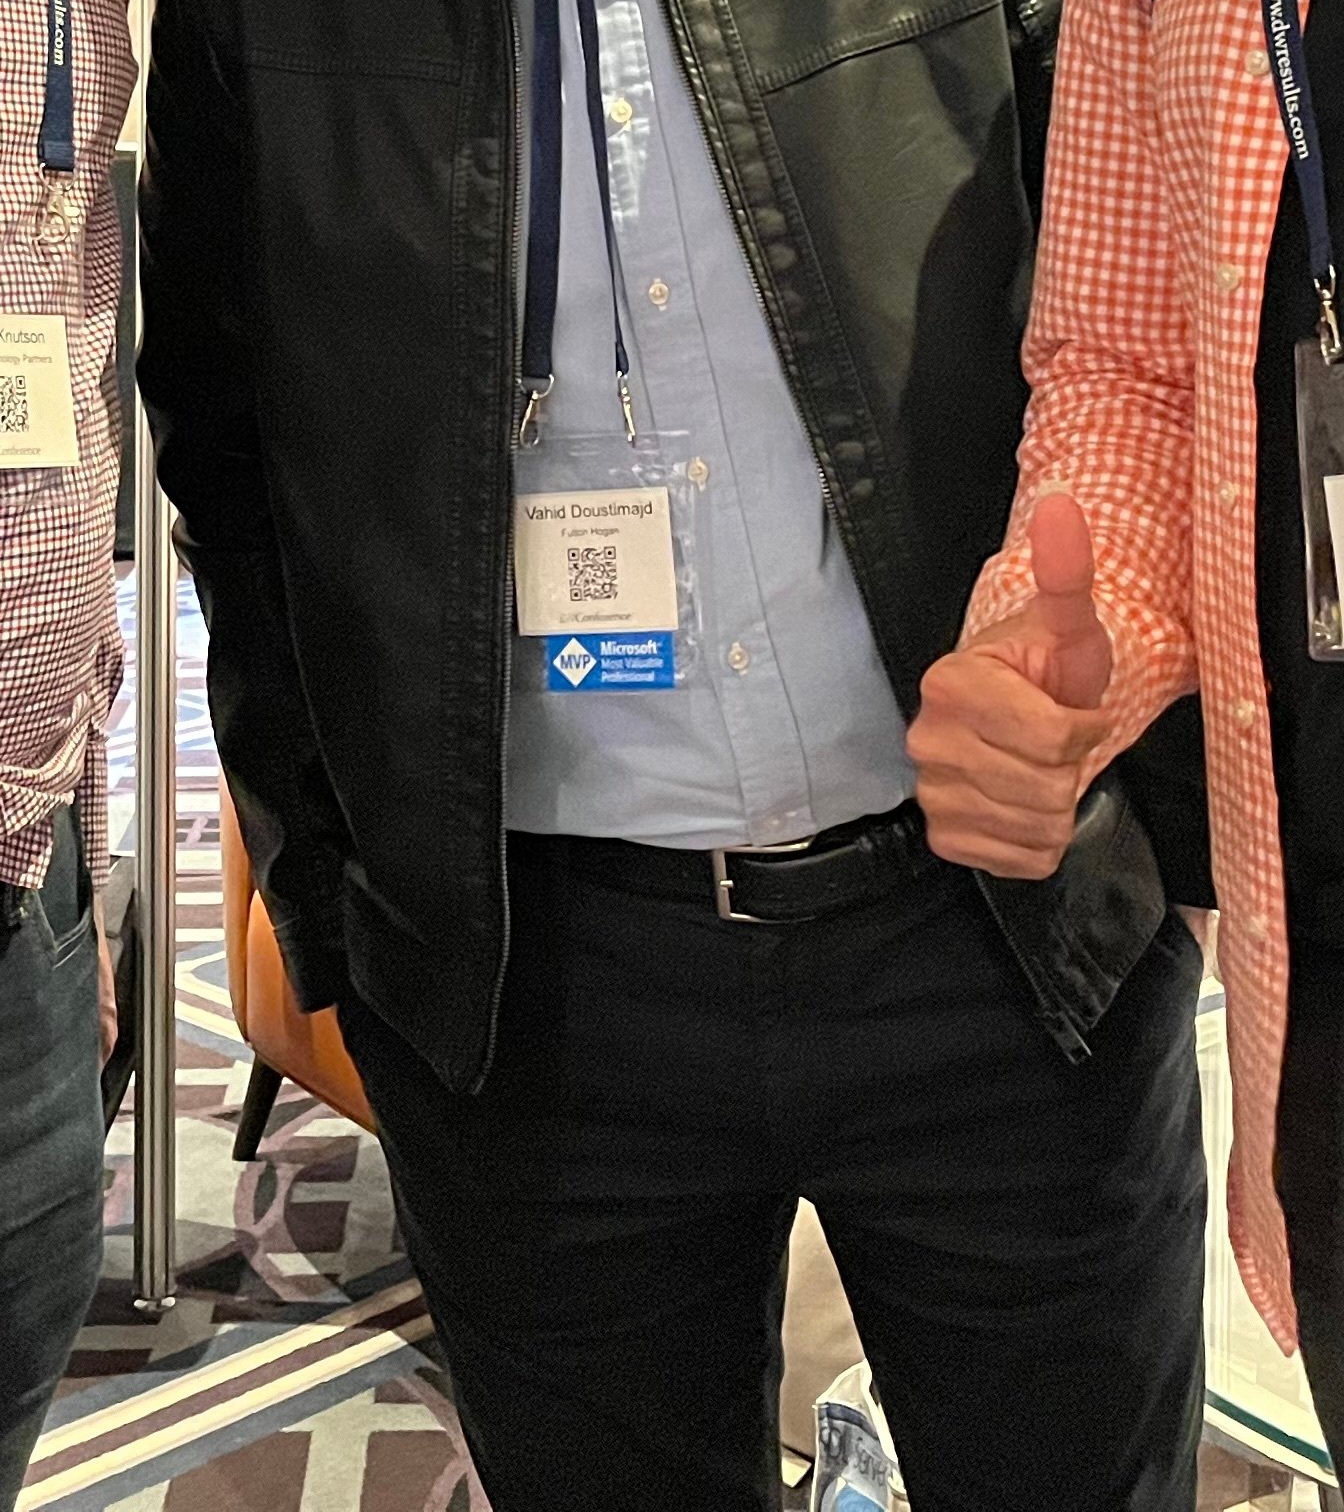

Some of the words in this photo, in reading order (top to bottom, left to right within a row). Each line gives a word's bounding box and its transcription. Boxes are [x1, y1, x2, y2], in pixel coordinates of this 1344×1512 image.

[526, 505, 566, 520] Vahid
[571, 501, 653, 520] Doustimajd
[601, 640, 657, 655] Microsoft
[560, 655, 591, 669] MVP
